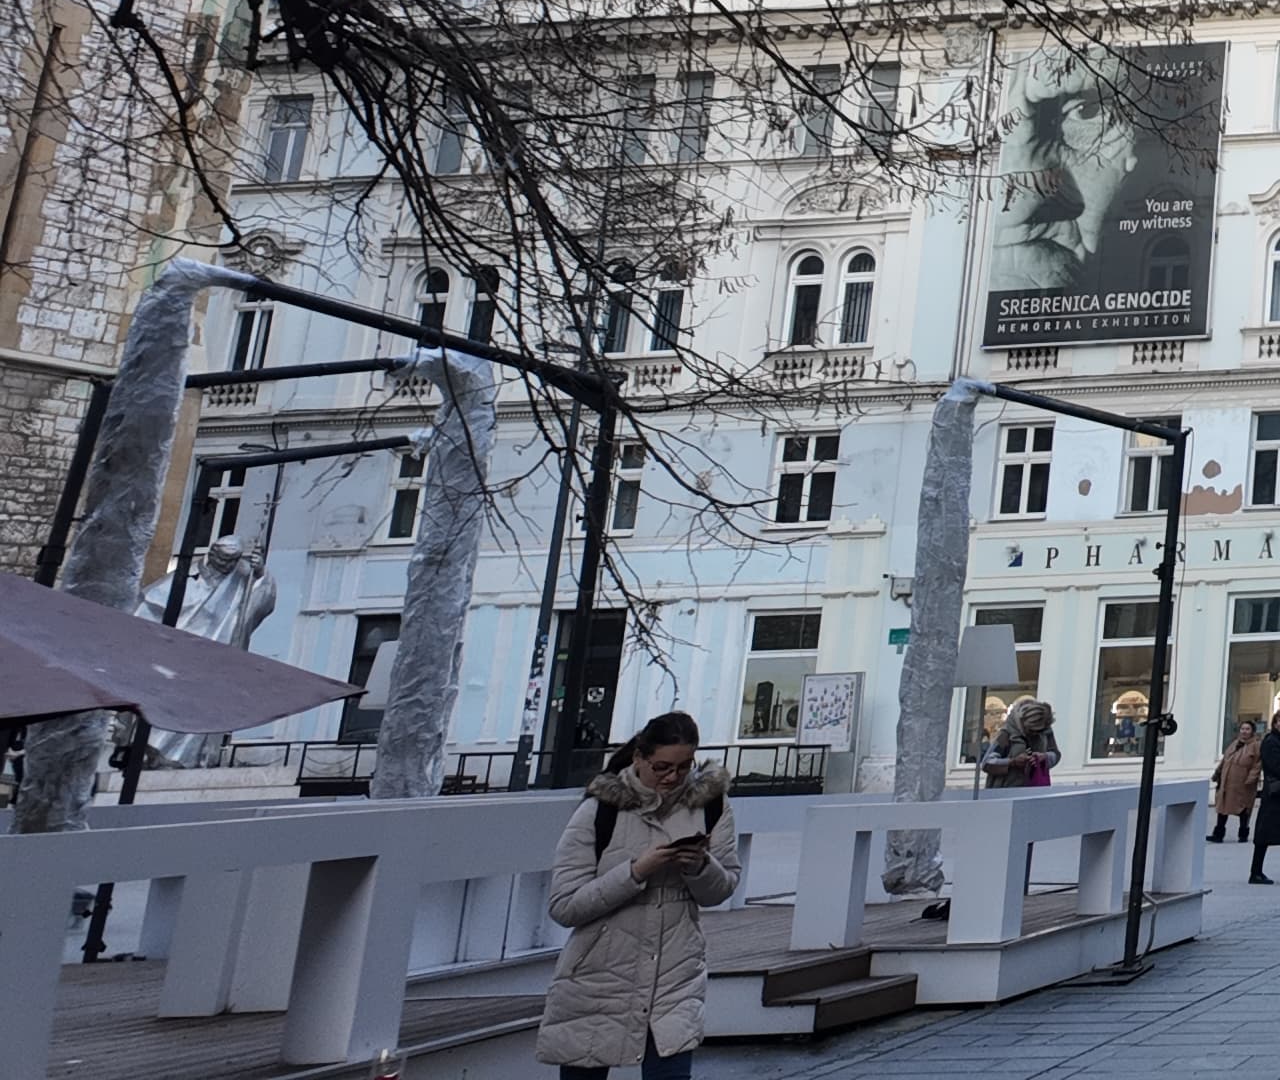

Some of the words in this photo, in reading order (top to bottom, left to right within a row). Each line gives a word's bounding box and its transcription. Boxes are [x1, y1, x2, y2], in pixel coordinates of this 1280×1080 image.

[1146, 60, 1204, 72] GALLERY
[1145, 199, 1169, 213] You
[1172, 200, 1194, 211] are
[1119, 219, 1139, 234] my
[1142, 214, 1192, 229] witness
[1000, 294, 1100, 316] SREBRENICA
[1105, 289, 1192, 310] GENOCIDE
[997, 319, 1082, 333] MEMORIAL
[1092, 313, 1190, 329] EXHIBITION
